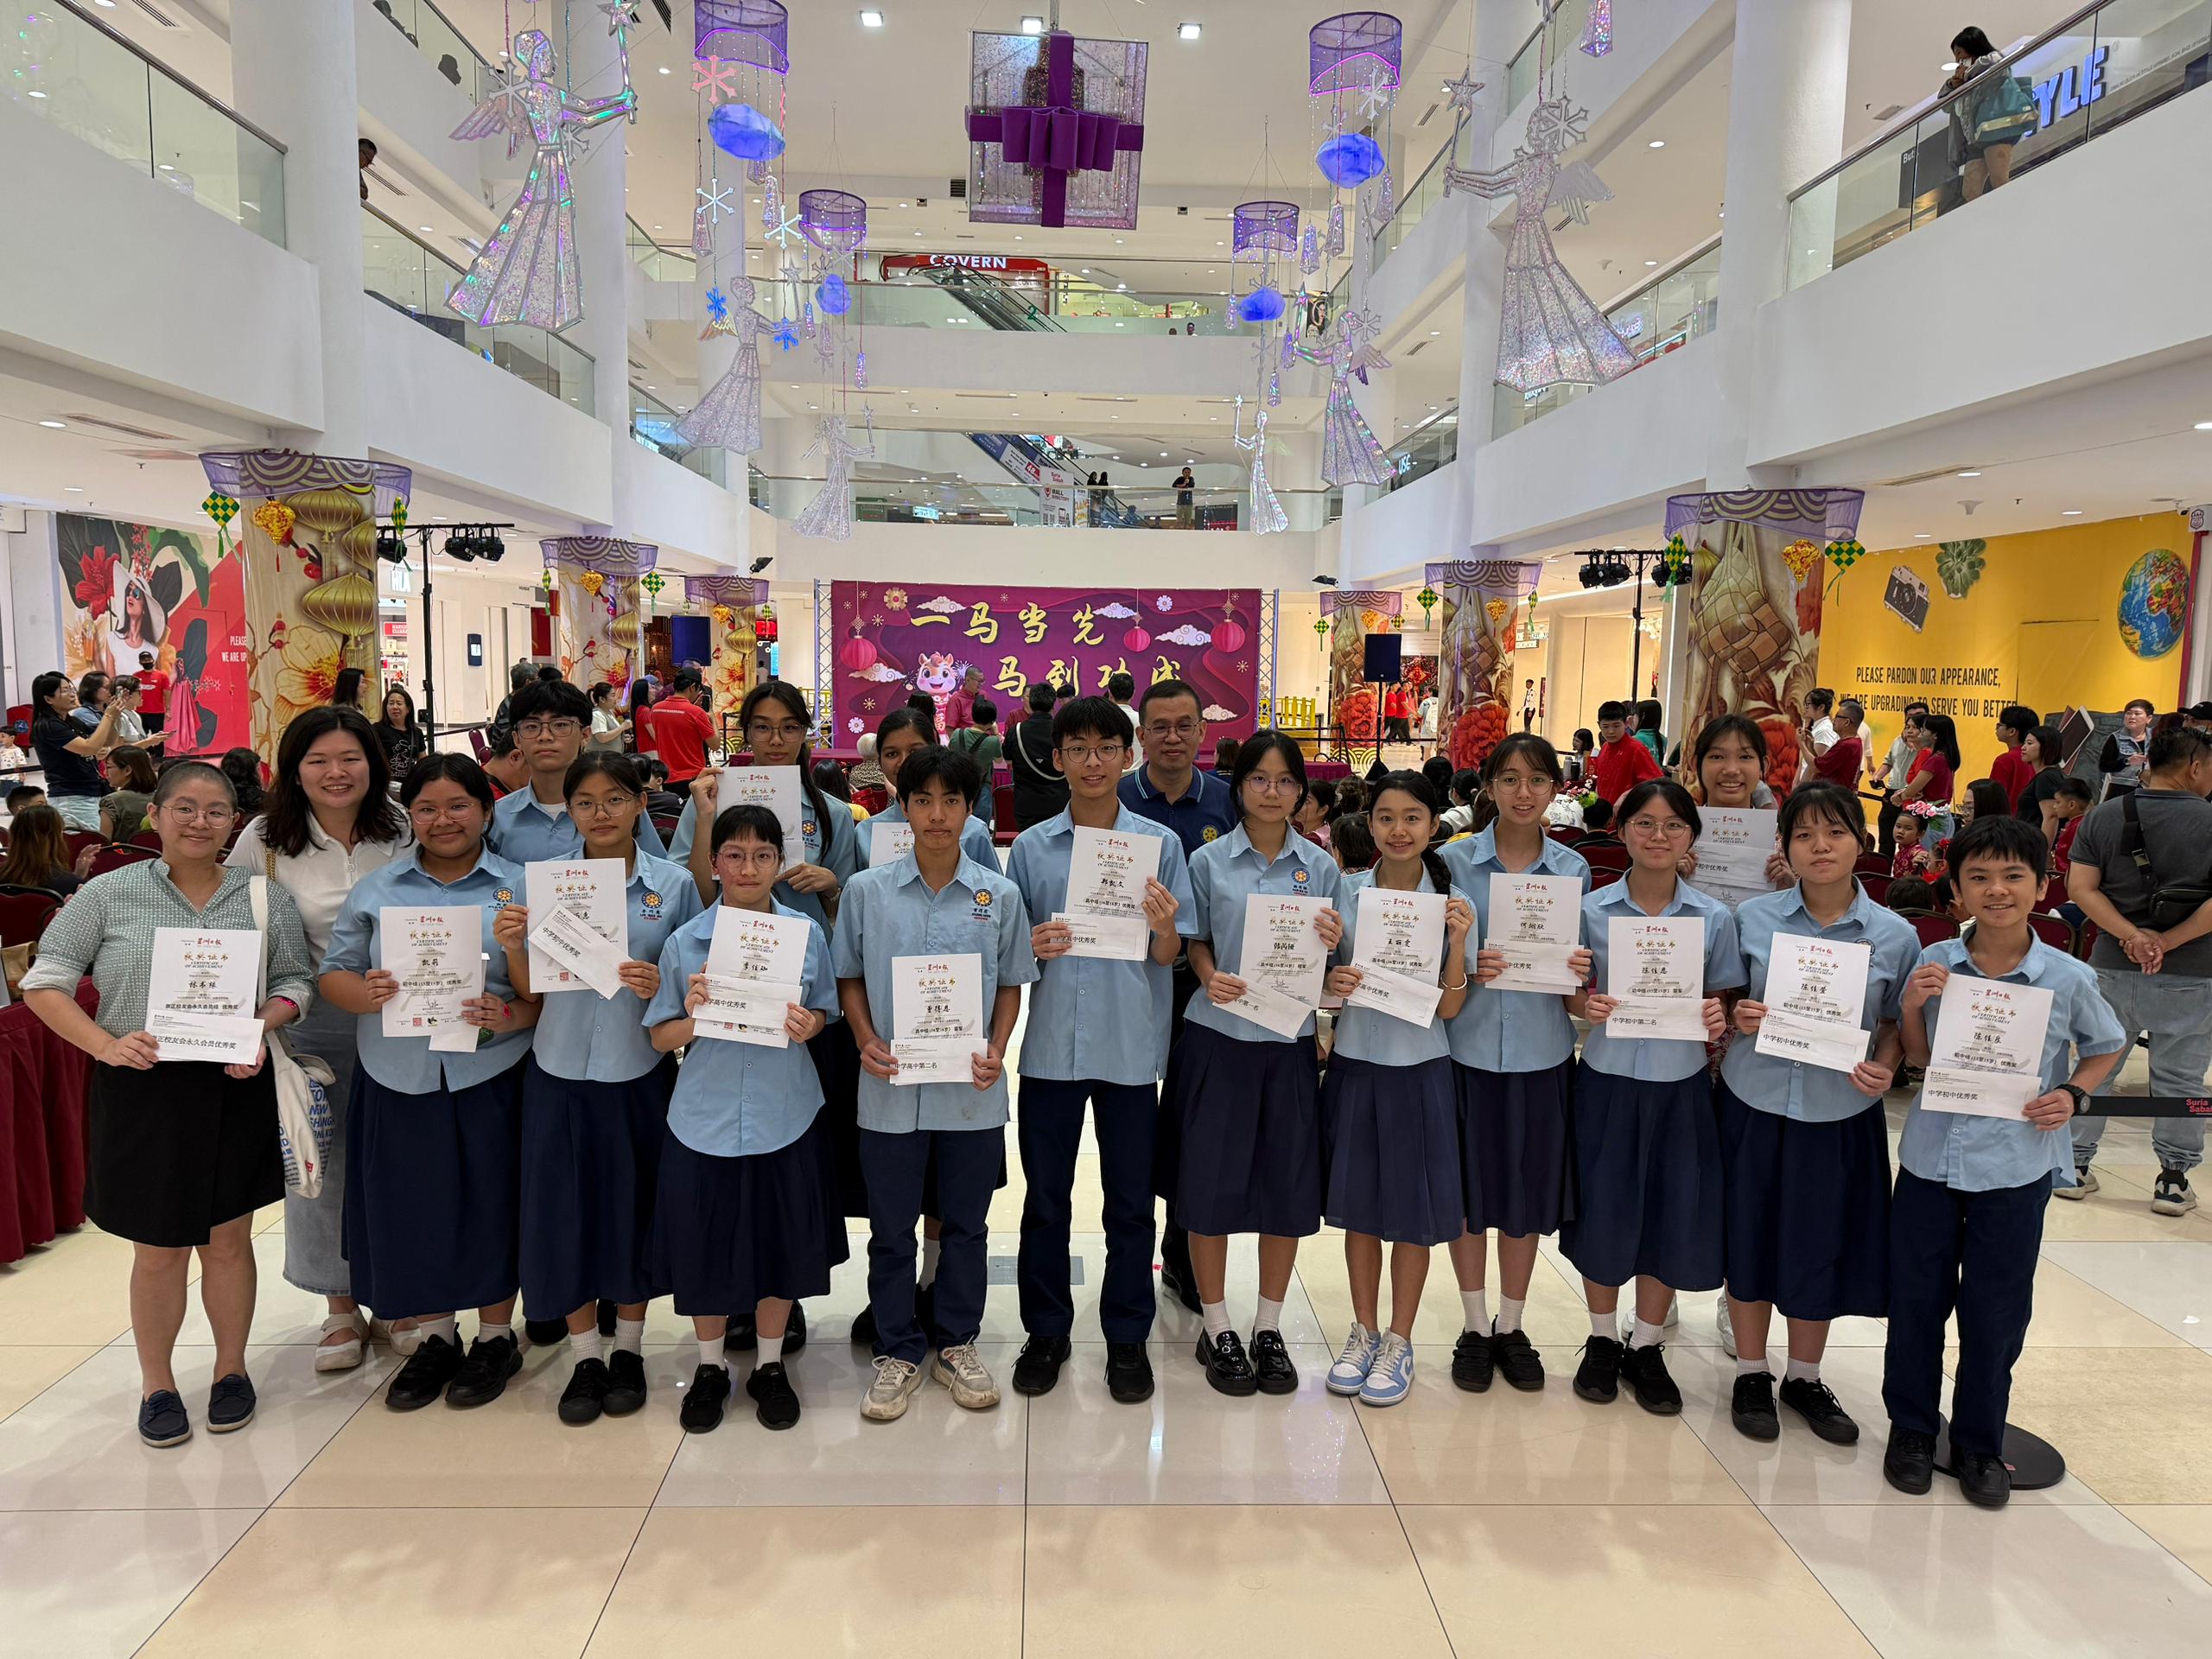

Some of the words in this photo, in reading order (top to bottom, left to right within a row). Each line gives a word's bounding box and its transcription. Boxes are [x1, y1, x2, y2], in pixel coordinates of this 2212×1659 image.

[910, 601, 1106, 645] 一马当先
[1857, 667, 1884, 683] PLEASE
[1886, 668, 1916, 684] PARDON
[1920, 668, 1936, 685] OUR
[1941, 668, 2000, 688] APPEARANCE,
[1931, 697, 1958, 715] SERVE
[1962, 698, 1979, 716] YOU
[1695, 863, 1728, 872] 初中优秀奖
[705, 998, 747, 1009] 学高中优秀奖
[1234, 998, 1259, 1011] 中第一名
[1612, 1017, 1657, 1026] 中学初中第二名
[1763, 1033, 1810, 1049] 中学初中优秀奖
[1928, 1090, 1978, 1100] 中学初中优秀奖
